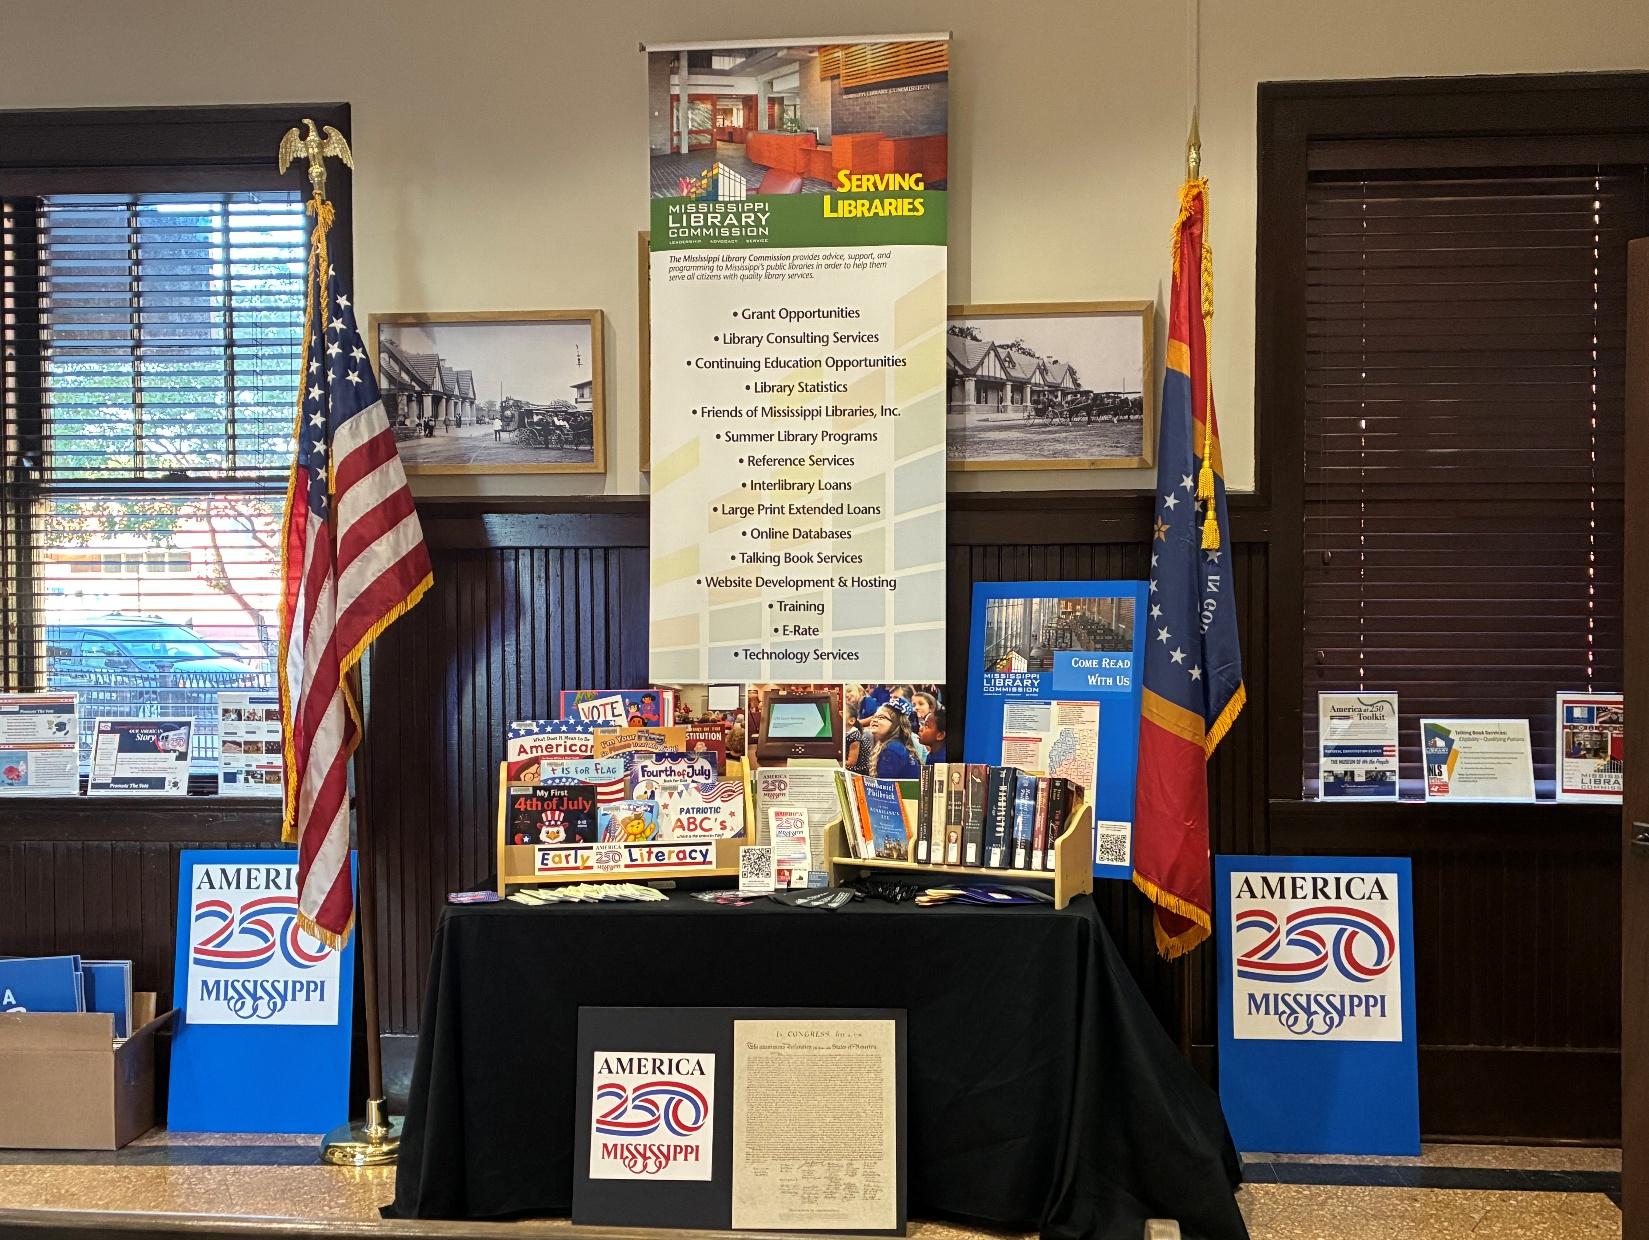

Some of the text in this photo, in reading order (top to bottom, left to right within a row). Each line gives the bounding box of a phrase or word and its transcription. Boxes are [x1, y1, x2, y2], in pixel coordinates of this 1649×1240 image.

[836, 169, 925, 193] SERVING
[668, 202, 769, 214] MISSISSIPPI
[823, 195, 925, 218] LIBRARIES
[668, 212, 771, 228] LIBRARY
[668, 227, 769, 238] COMMISSION
[669, 250, 892, 264] The Mississippi Library Commission provides advice, support, and
[669, 264, 715, 274] programming
[716, 264, 724, 272] to
[725, 262, 765, 273] Mississippi's
[766, 262, 787, 272] public
[788, 262, 815, 271] libraries
[824, 261, 845, 270] order
[844, 261, 852, 269] to
[852, 260, 868, 271] help
[869, 260, 887, 269] them
[696, 272, 721, 280] citizens
[723, 271, 739, 280] with
[739, 271, 762, 282] quality
[764, 271, 787, 281] library
[787, 272, 815, 280] services.
[741, 307, 860, 322] Grant Opportunities
[723, 331, 880, 347] Library Consulting Services
[695, 355, 907, 372] Continuing Education Opportunities
[754, 381, 848, 396] Library Statistics
[701, 405, 901, 420] Friends of Mississippi Libraries, Inc.
[724, 430, 878, 445] Summer Library Programs
[747, 454, 855, 466] Reference Services
[750, 479, 852, 494] Interlibrary Loans
[721, 503, 881, 518] Large Print Extended Loans
[750, 527, 852, 539] Online Databases
[739, 552, 863, 566] Talking Book Services
[705, 576, 897, 591] Website Development & Hosting
[777, 600, 825, 615] Training
[782, 624, 820, 636] E-Rate
[742, 648, 860, 664] Technology Services
[983, 678, 1041, 687] LIBRARY
[581, 700, 623, 721] VOTE
[1329, 705, 1363, 713] America
[1369, 705, 1384, 713] 250
[1357, 713, 1386, 721] Toolkit
[135, 734, 157, 742] Story
[616, 734, 636, 742] Your
[686, 732, 722, 740] STITUTION
[640, 765, 711, 779] Fourth of July
[1428, 764, 1443, 776] NLS
[536, 789, 568, 798] My First
[867, 787, 896, 800] Philbrick
[514, 796, 592, 813] 4th of July
[680, 806, 721, 815] PATRIOTIC
[994, 785, 1008, 837] WASHINGTON
[672, 816, 728, 832] ABC's
[540, 847, 709, 869] Early Literacy
[595, 850, 623, 864] 250
[196, 867, 299, 890] AMERI
[1235, 875, 1389, 900] AMERICA
[1236, 906, 1395, 983] 250
[200, 979, 326, 1019] MISSISSIPPI
[1247, 993, 1387, 1035] MISSISSIPPI
[597, 1057, 707, 1076] AMERICA
[596, 1081, 708, 1137] 250
[601, 1143, 700, 1174] MISSISSIPPI
